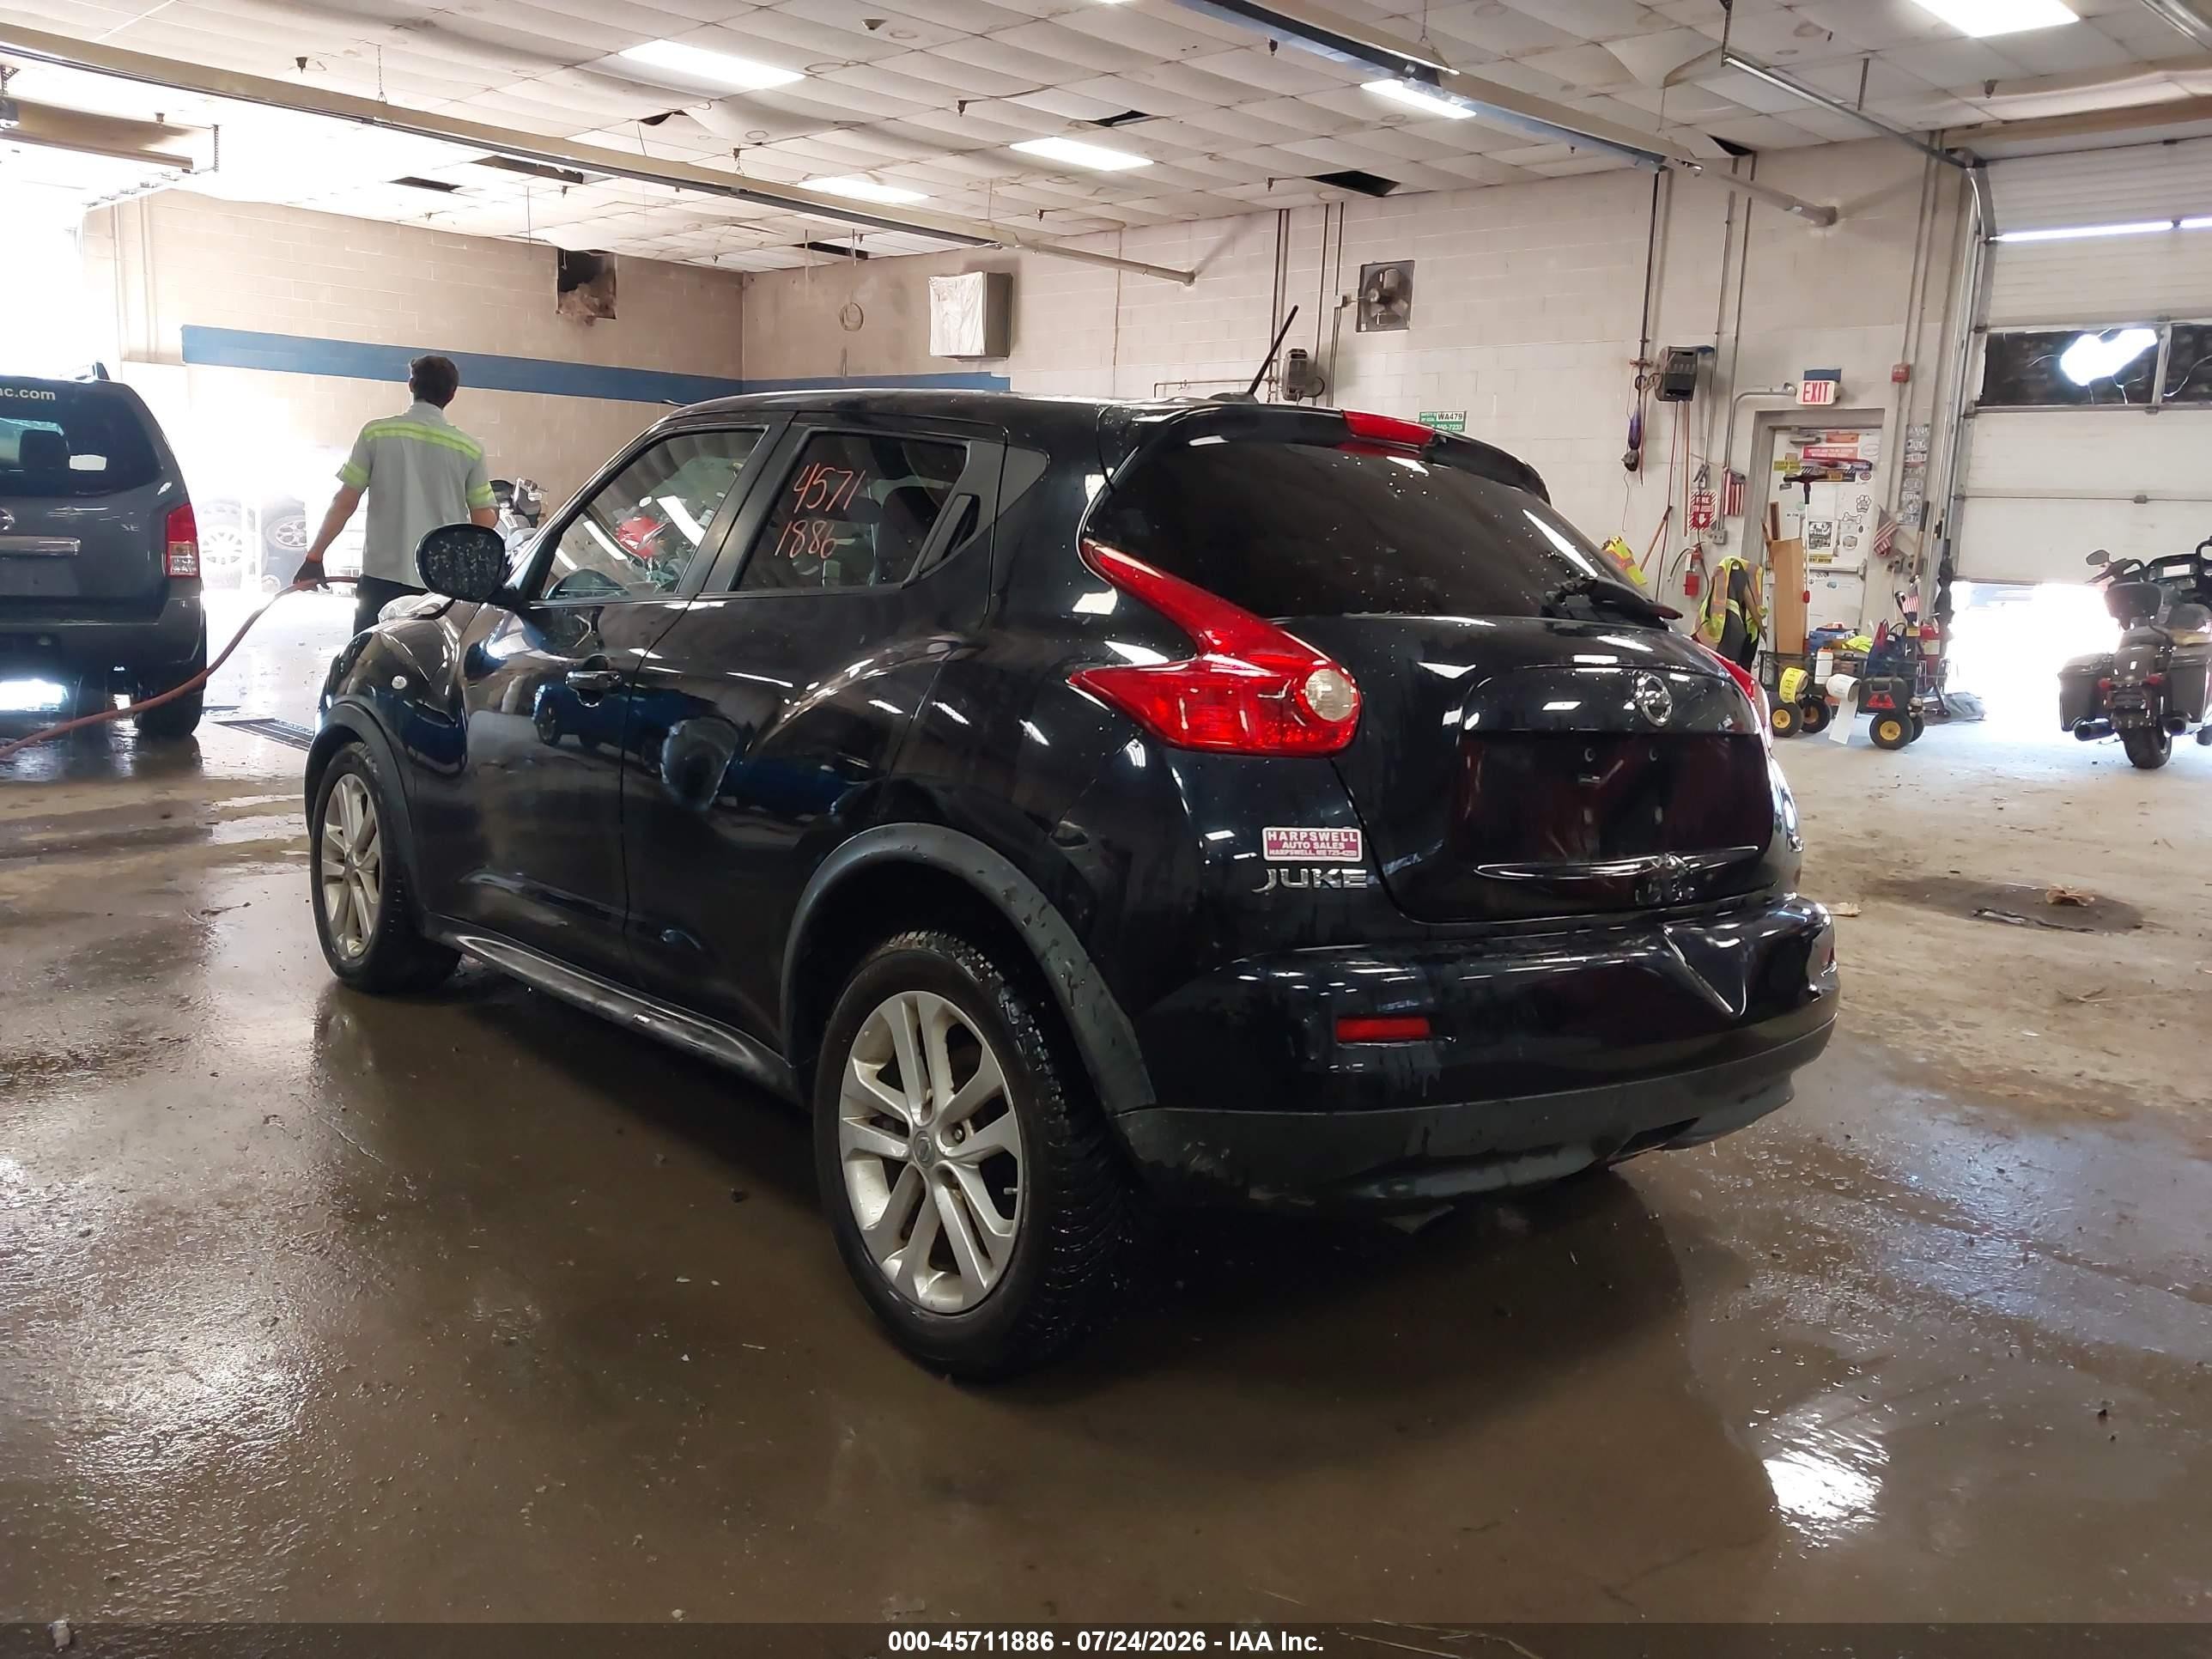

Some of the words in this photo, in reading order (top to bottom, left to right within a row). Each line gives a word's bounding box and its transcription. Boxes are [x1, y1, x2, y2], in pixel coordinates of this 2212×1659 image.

[1802, 381, 1830, 403] EXIT
[1437, 412, 1463, 421] WA479
[793, 463, 866, 514] 4571
[775, 520, 838, 559] 1886
[1267, 830, 1358, 842] HARPSWELL
[1282, 841, 1311, 849] AUTO
[1312, 842, 1346, 850] SALES
[1251, 867, 1368, 893] JUKE
